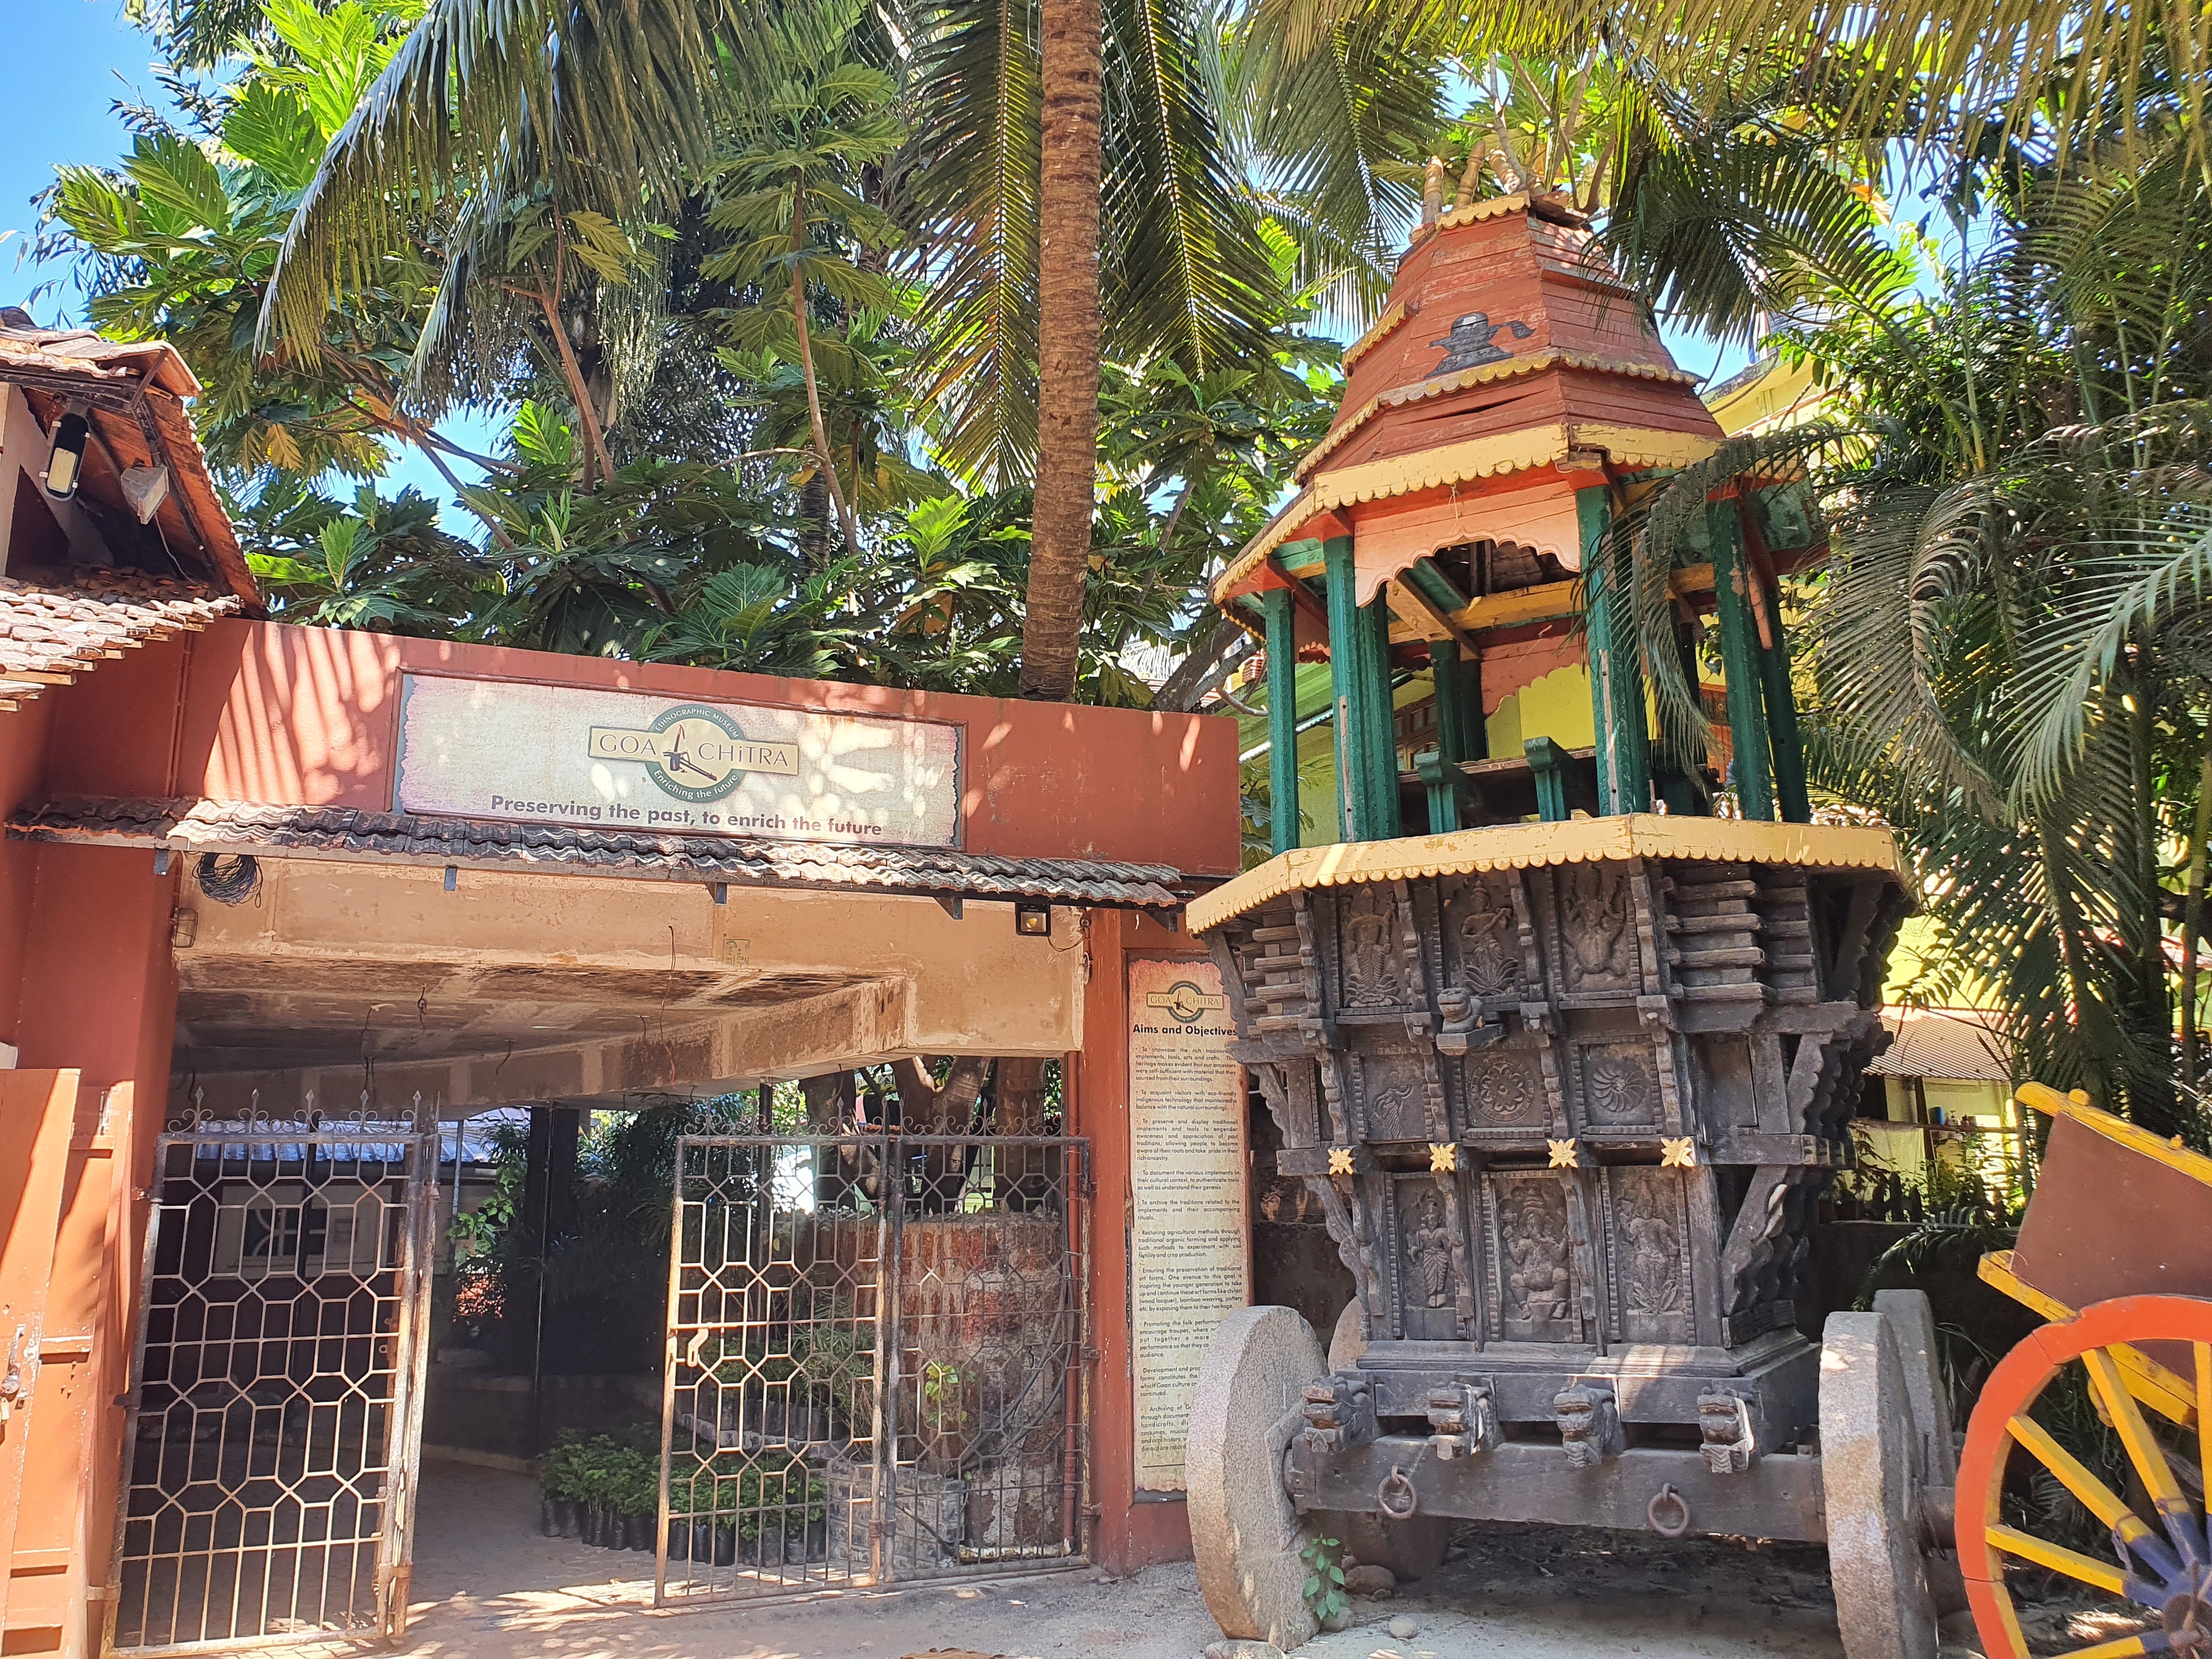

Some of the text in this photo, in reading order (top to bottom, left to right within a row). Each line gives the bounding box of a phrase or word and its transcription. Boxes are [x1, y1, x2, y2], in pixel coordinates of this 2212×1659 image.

[655, 708, 740, 738] ETHNOGRAPHIC MUSEUM
[599, 734, 656, 757] GOA
[653, 769, 738, 800] Enriching the future
[491, 795, 882, 836] Preserving the past, to enrich the future
[1150, 996, 1171, 1004] GOA
[1133, 1024, 1237, 1037] Aims and Objectives
